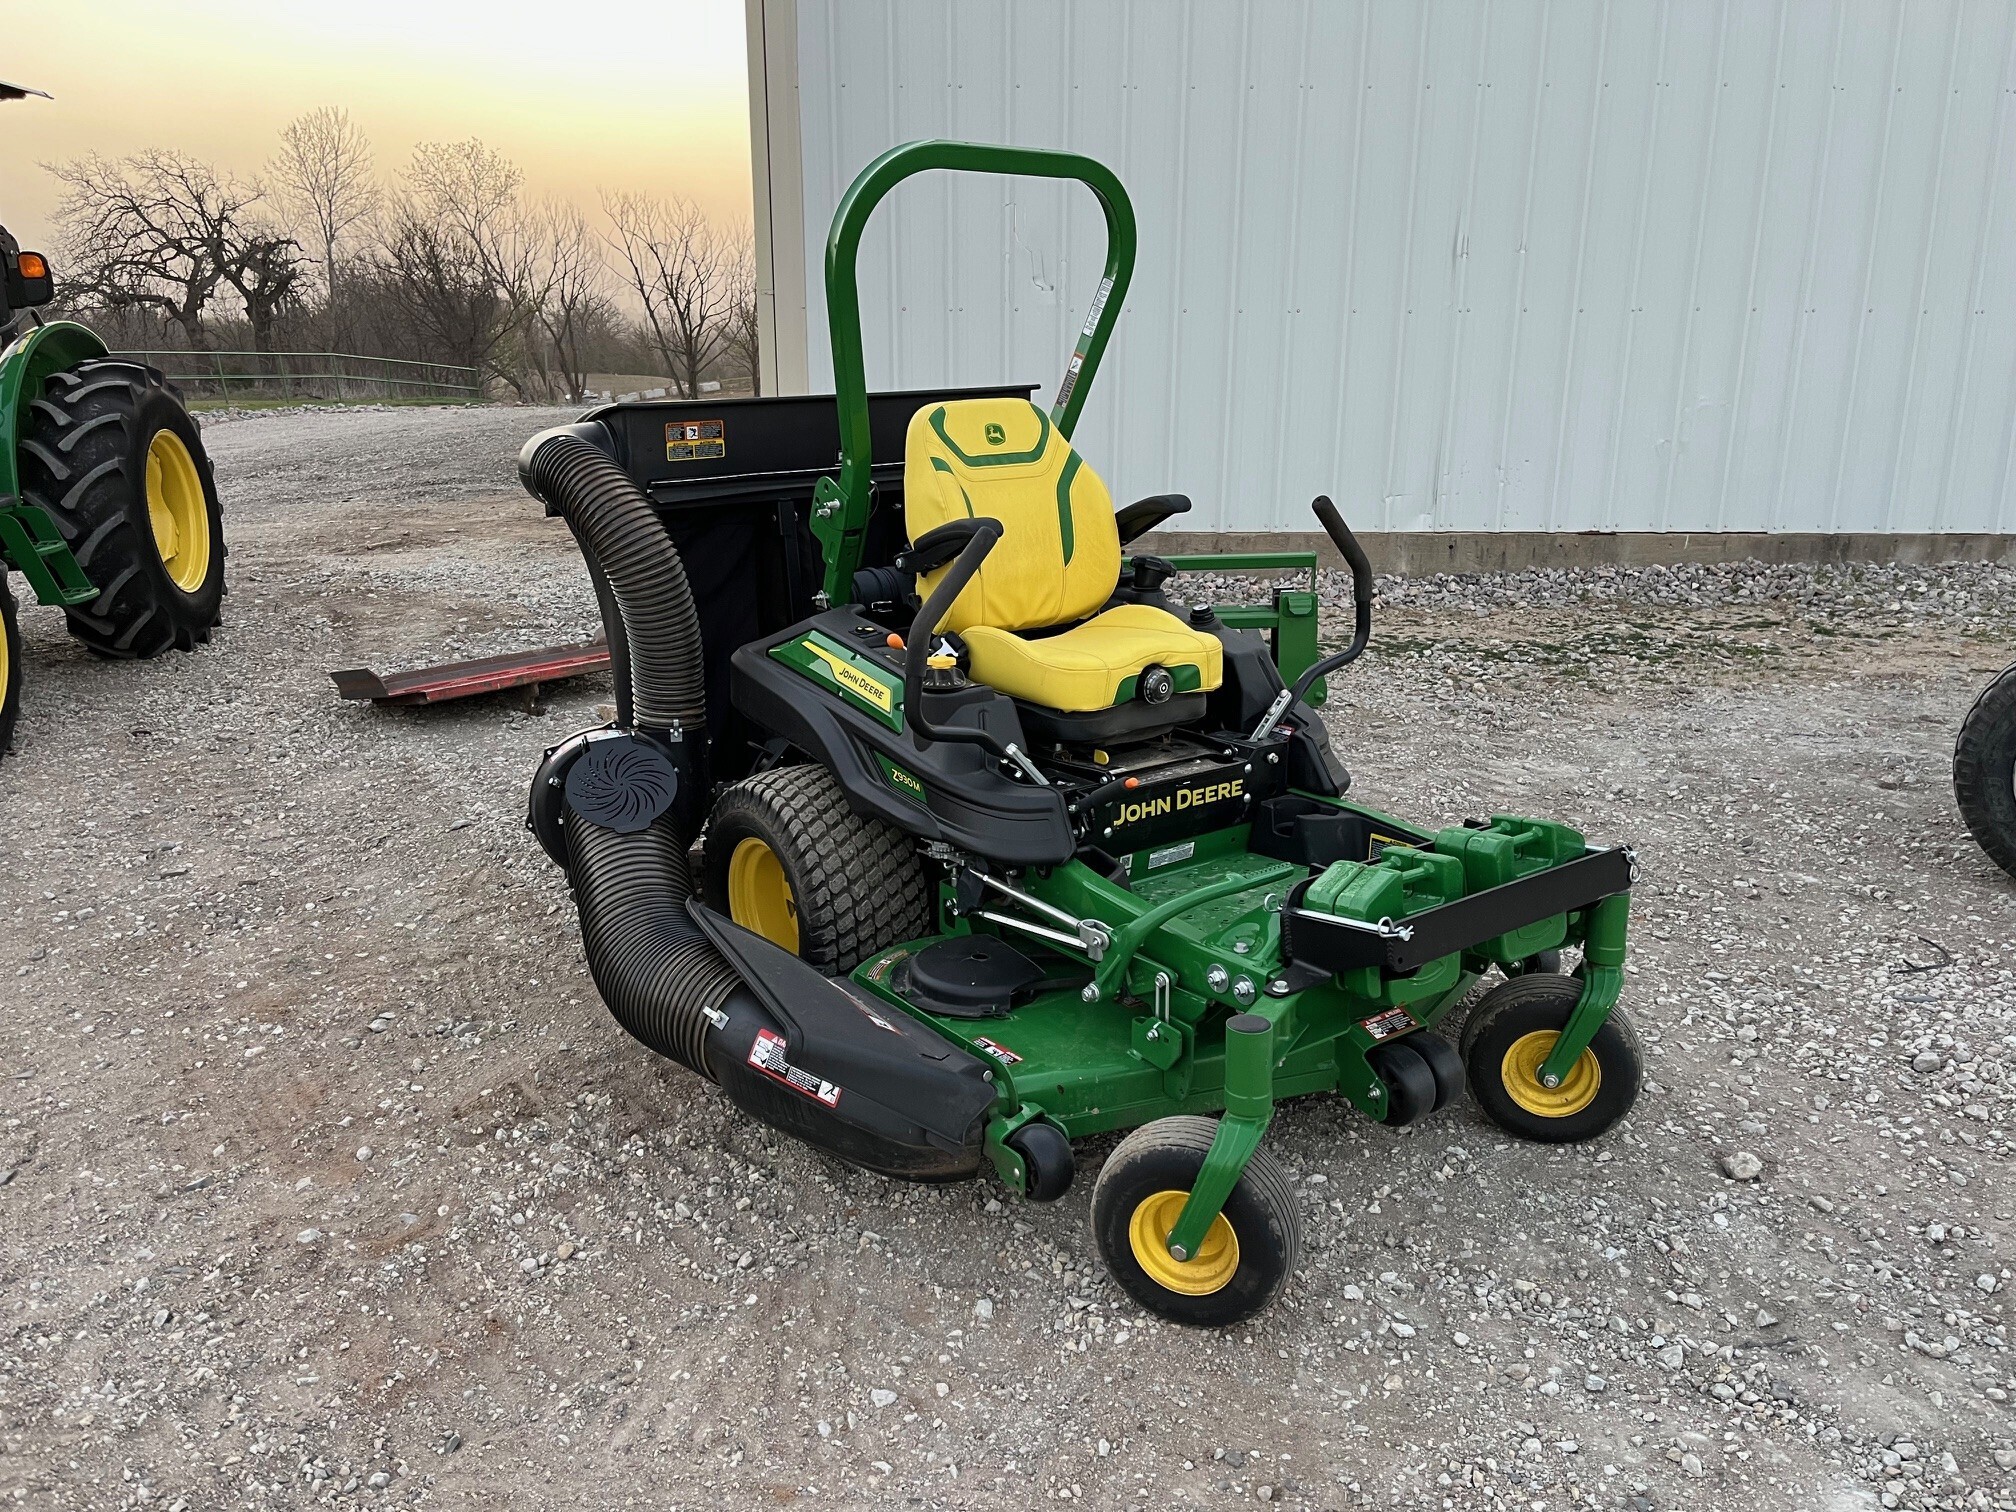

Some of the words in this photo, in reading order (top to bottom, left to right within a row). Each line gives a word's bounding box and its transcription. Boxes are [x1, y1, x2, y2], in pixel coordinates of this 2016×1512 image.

[838, 667, 860, 685] JOHN
[858, 678, 885, 700] DEERE
[891, 768, 921, 792] Z930M
[1113, 796, 1171, 826] JOHN
[1176, 779, 1244, 811] DEERE
